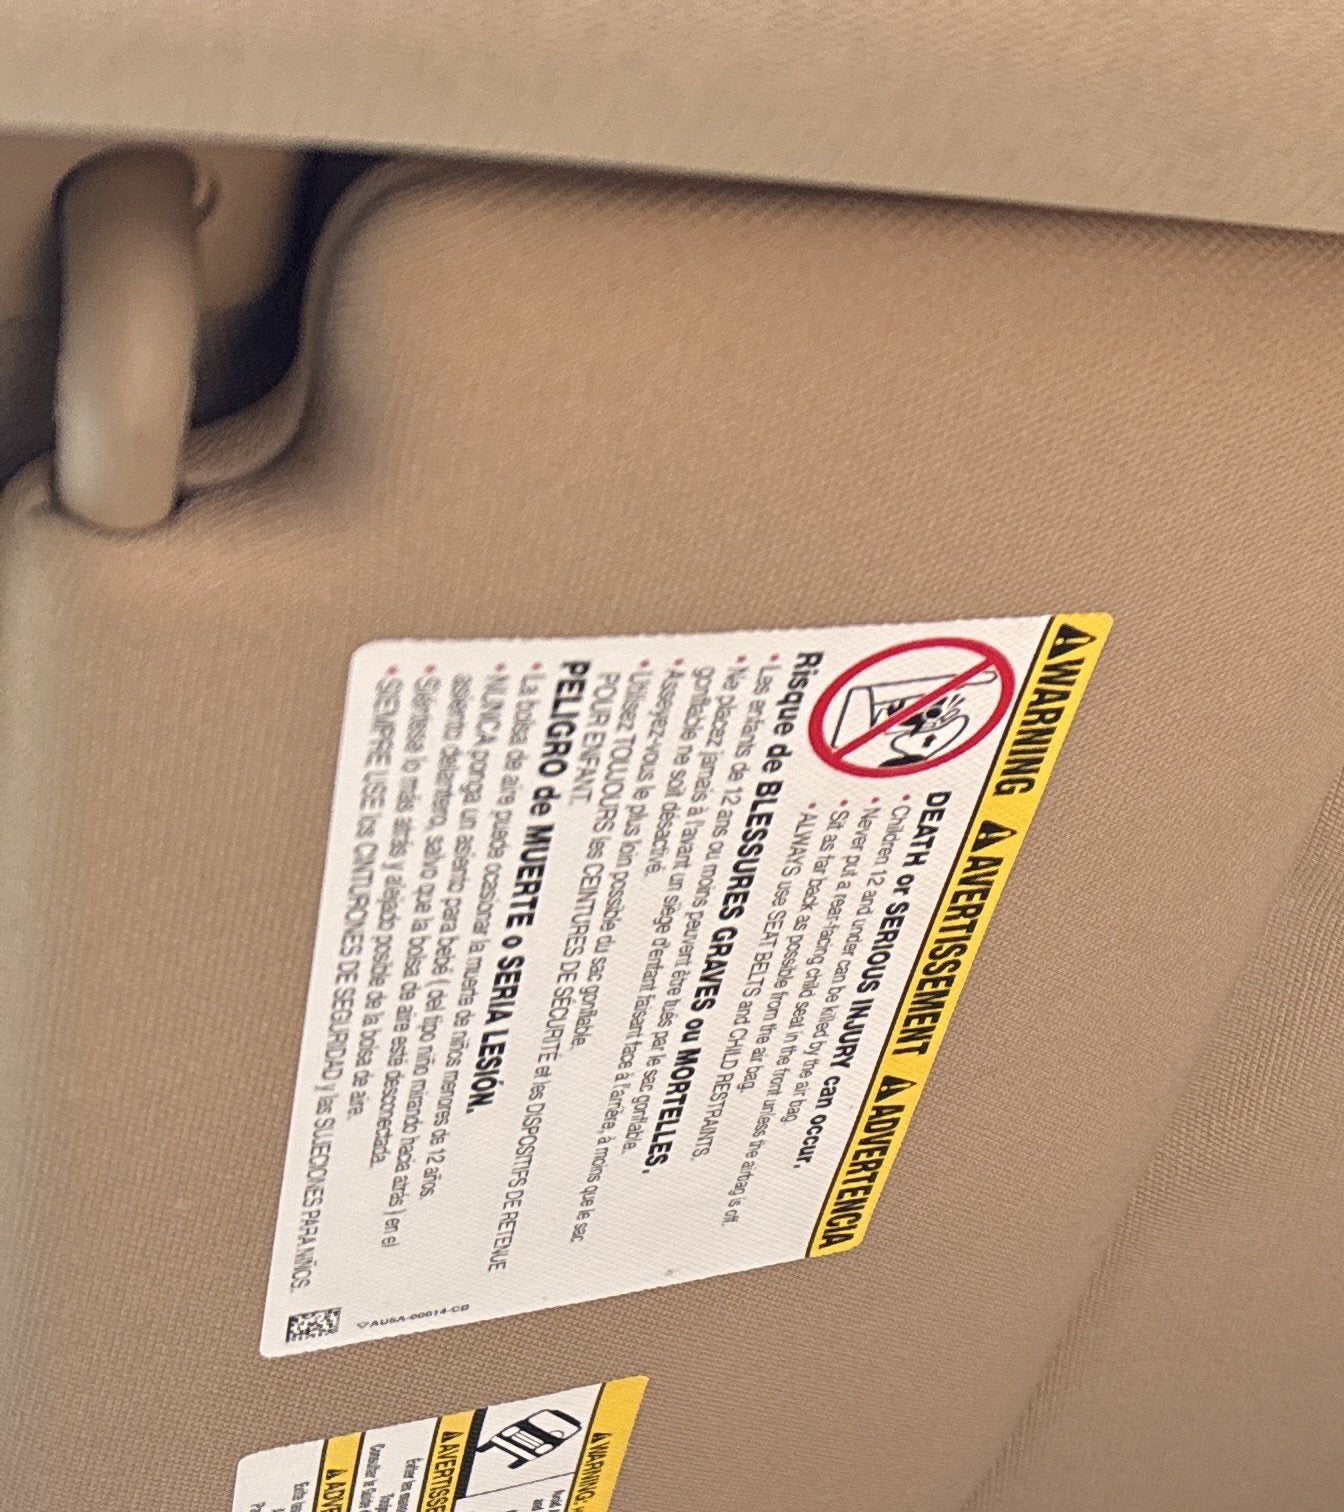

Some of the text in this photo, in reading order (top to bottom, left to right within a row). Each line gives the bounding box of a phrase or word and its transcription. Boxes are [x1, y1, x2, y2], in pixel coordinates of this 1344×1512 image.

[721, 666, 750, 692] Ne
[751, 664, 783, 696] Les
[585, 671, 622, 728] POUR
[678, 665, 716, 742] gonflable
[635, 668, 687, 783] Asseyez-vous
[704, 694, 738, 748] placez
[733, 699, 767, 759] enfants
[672, 744, 694, 767] ne
[663, 768, 688, 799] soit
[689, 749, 725, 804] jamais
[726, 761, 751, 783] de
[631, 784, 657, 801] le
[719, 785, 744, 807] 12
[622, 803, 650, 838] plus
[685, 805, 710, 818] à
[710, 808, 734, 839] ans
[849, 806, 882, 852] Never
[873, 804, 913, 866] Children
[615, 838, 643, 869] loin
[671, 819, 706, 871] l'avant
[704, 840, 725, 862] ou
[666, 872, 686, 892] un
[839, 854, 862, 879] put
[865, 869, 888, 888] 12
[465, 660, 592, 1115] PELIGRO de MUERTE o SERIA LESIÓN.
[598, 870, 630, 933] possible
[690, 863, 719, 909] moins
[834, 880, 852, 892] a
[641, 651, 825, 1174] Risque de BLESSURES GRAVES ou MORTELLES.
[652, 894, 683, 935] siège
[855, 889, 878, 917] and
[592, 934, 617, 955] du
[673, 909, 705, 969] peuvent
[804, 893, 848, 967] rear-facing
[840, 917, 867, 957] under
[638, 936, 672, 993] d'enfant
[735, 809, 851, 1094] Sit as far back as possible from the air bag.
[817, 657, 1086, 1250] WARNING AVERTISSEMENT ADVERTENCIA
[487, 670, 654, 1273] Utilisez TOUJOURS les CEINTURES DE SÉCURITÉ et les DISPOSITIFS DE RETENUE
[585, 956, 608, 983] sac
[665, 969, 692, 997] être
[793, 790, 953, 1169] DEATH or SERIOUS INJURY can occur.
[797, 967, 823, 999] child
[831, 959, 852, 985] can
[690, 811, 819, 1162] ALWAYS use SEAT BELTS and CHILD RESTRAINTS.
[824, 984, 847, 1004] be
[625, 993, 657, 1041] faisant
[656, 997, 683, 1029] tués
[787, 1000, 810, 1030] seat
[811, 1004, 840, 1040] killed
[650, 1029, 670, 1052] par
[782, 1030, 804, 1044] in
[802, 1040, 828, 1057] by
[617, 1040, 644, 1070] face
[645, 1053, 668, 1068] le
[775, 1044, 798, 1067] the
[797, 1057, 821, 1079] the
[613, 1071, 635, 1083] à
[638, 1068, 659, 1093] sac
[765, 1067, 792, 1097] front
[792, 1080, 811, 1097] air
[751, 1098, 777, 1139] unless
[596, 1135, 617, 1146] à
[744, 1138, 767, 1159] the
[586, 1146, 610, 1184] moins
[727, 1160, 757, 1197] airbag
[579, 1184, 599, 1208] que
[727, 1196, 747, 1208] is
[575, 1208, 596, 1221] le
[569, 1221, 589, 1244] sac
[572, 1440, 611, 1506] WARNING:
